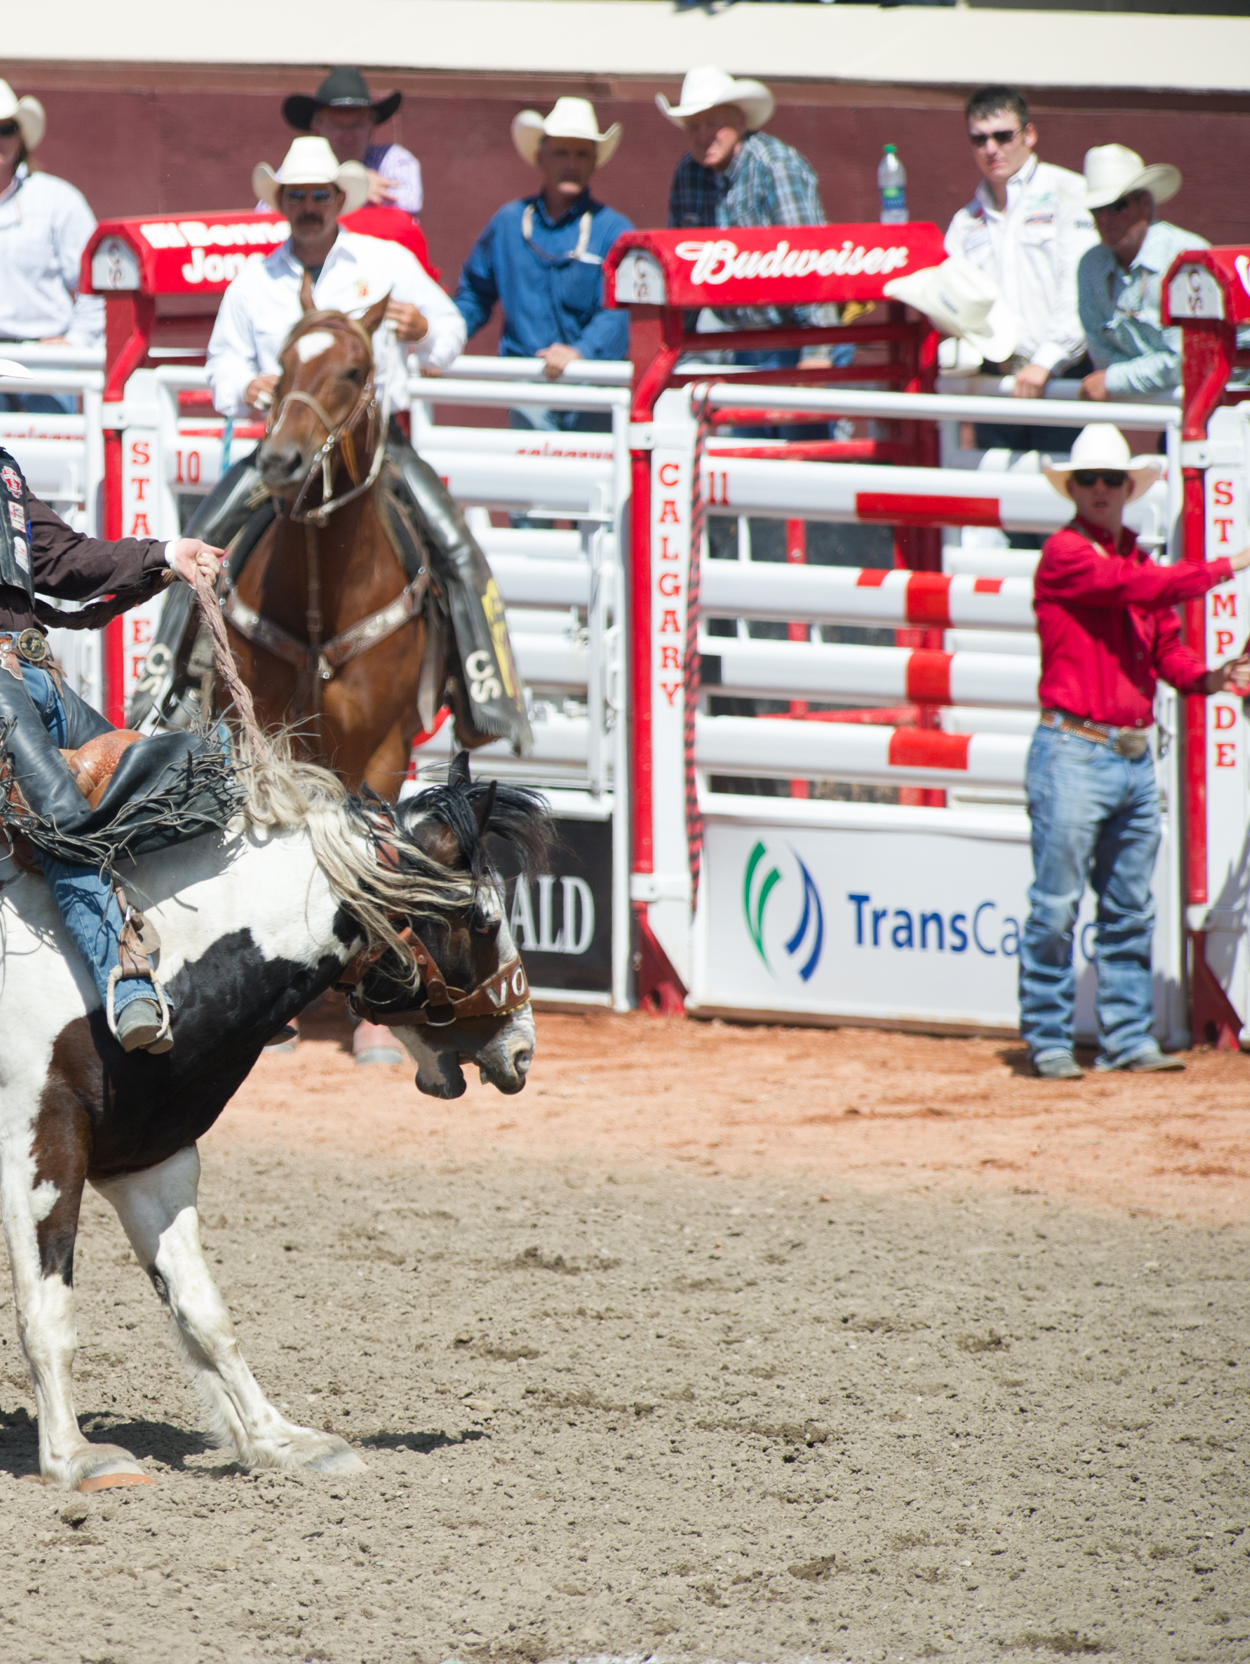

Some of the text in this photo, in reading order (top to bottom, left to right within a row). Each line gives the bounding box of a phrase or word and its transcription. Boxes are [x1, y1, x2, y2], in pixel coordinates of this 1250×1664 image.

[182, 247, 264, 284] Jon
[675, 240, 909, 285] Budweiser
[176, 450, 200, 484] 10
[707, 471, 730, 505] 11
[658, 463, 682, 706] CALGARY
[1211, 481, 1237, 767] STMPDE
[465, 649, 502, 703] CS
[509, 874, 596, 956] ALD
